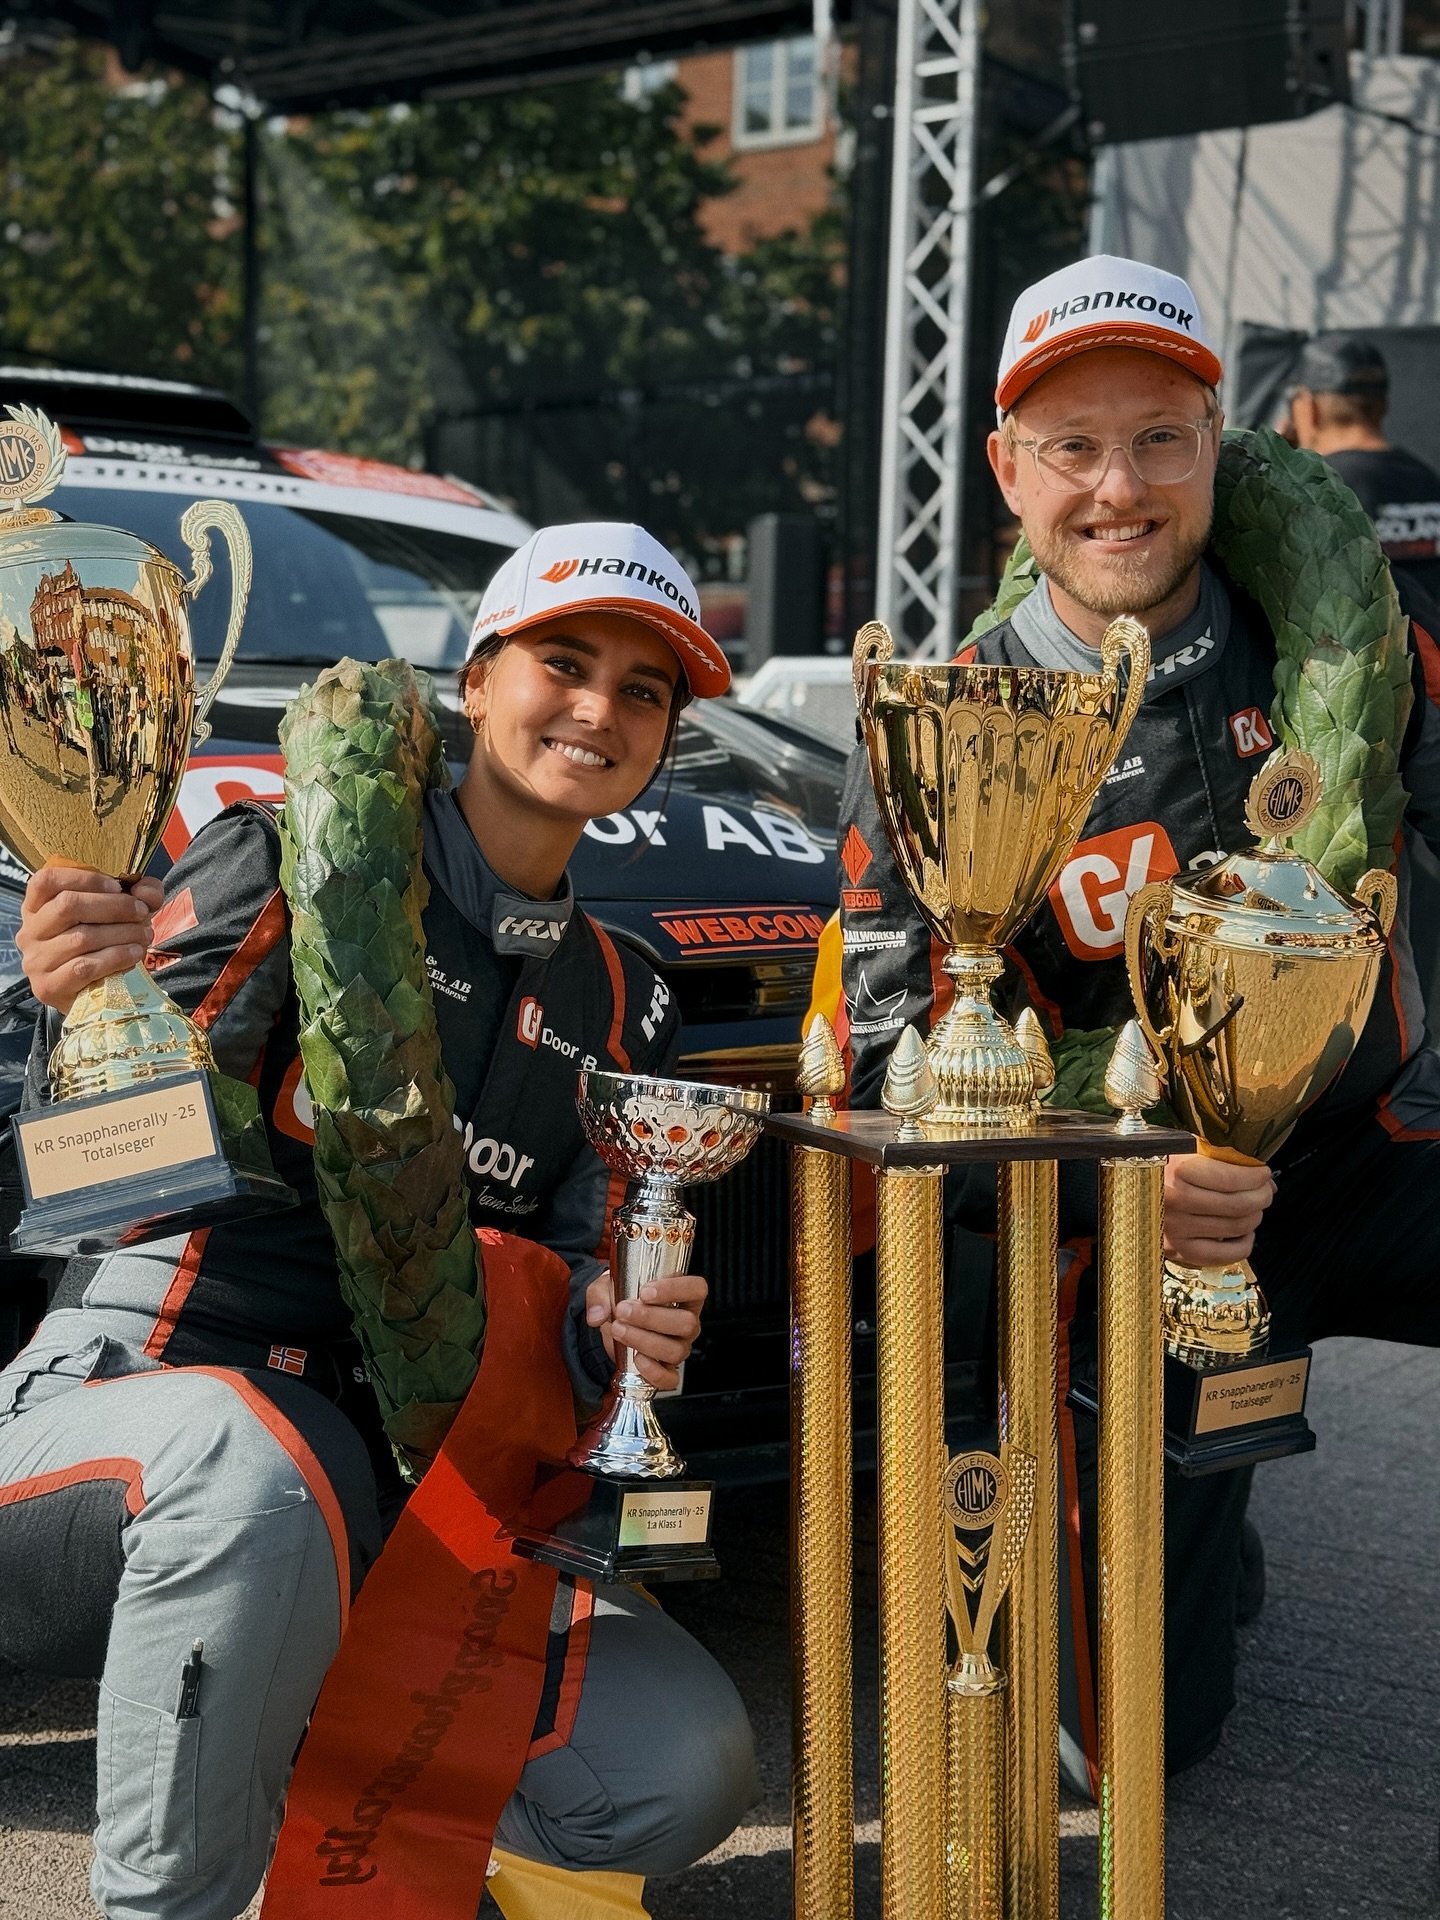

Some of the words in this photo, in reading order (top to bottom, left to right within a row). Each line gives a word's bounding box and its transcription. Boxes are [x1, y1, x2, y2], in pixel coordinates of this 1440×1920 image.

[1147, 626, 1215, 682] HRX
[1233, 710, 1269, 753] GK
[1122, 755, 1143, 771] AB
[583, 809, 668, 846] or
[702, 805, 826, 864] AB
[659, 913, 825, 945] WEBCON
[425, 955, 438, 966] &
[449, 979, 472, 994] AB
[541, 1027, 580, 1059] Door
[34, 1139, 55, 1155] KR
[58, 1112, 168, 1150] Snapphanerally
[172, 1103, 197, 1120] -25
[81, 1135, 156, 1163] Totalseger
[1205, 1390, 1219, 1402] KR
[1219, 1377, 1285, 1399] Snapphanerally
[1286, 1373, 1301, 1385] -25
[1230, 1394, 1274, 1411] Totalseger
[957, 1469, 995, 1511] HLMK
[627, 1508, 638, 1518] KR
[638, 1507, 692, 1518] Snapphanerally
[692, 1506, 705, 1516] -25
[658, 1519, 677, 1529] Klass
[678, 1520, 682, 1529] 1
[948, 1497, 1003, 1523] MOTORKLUBB
